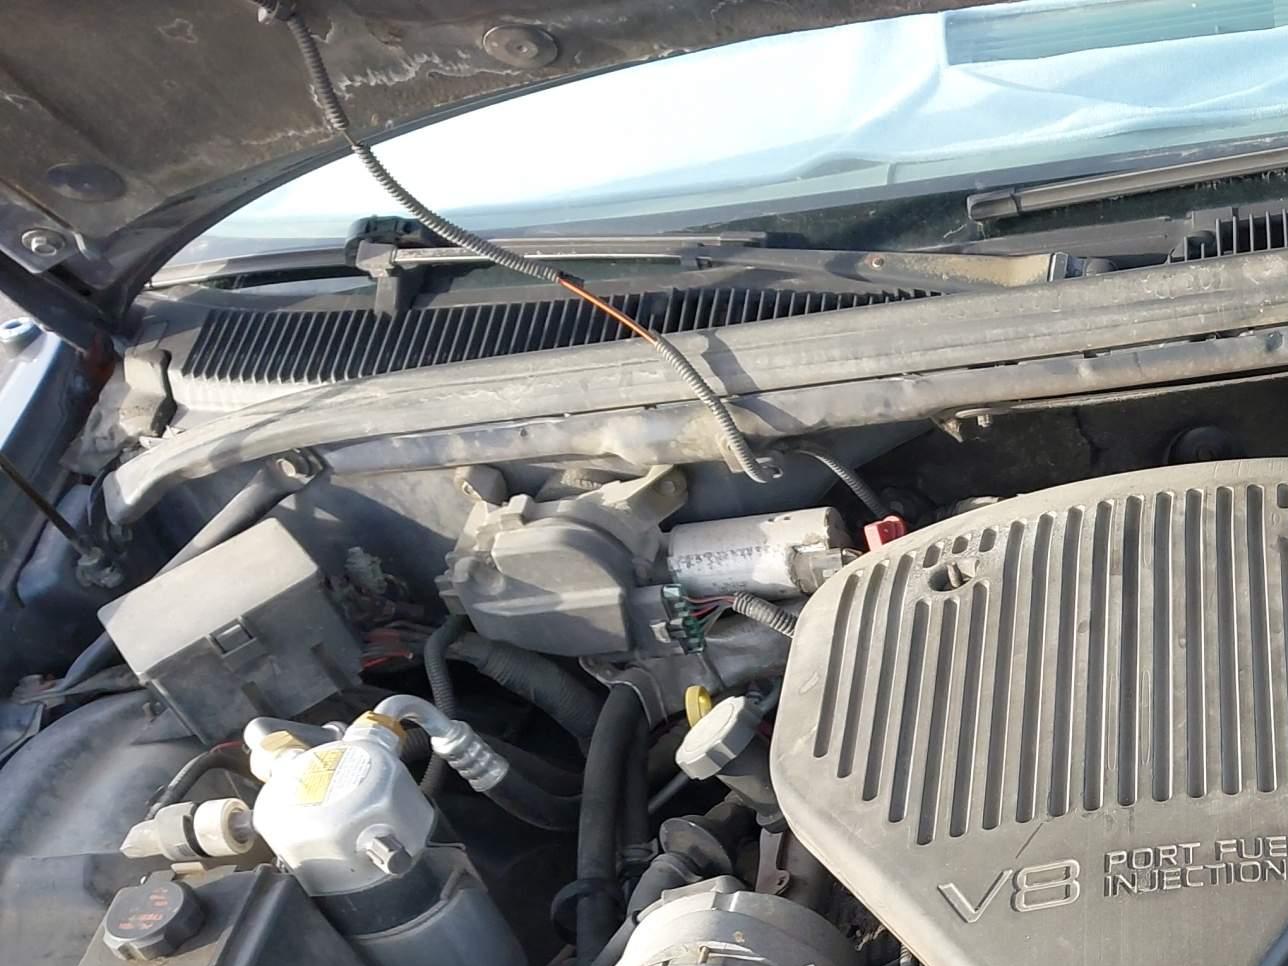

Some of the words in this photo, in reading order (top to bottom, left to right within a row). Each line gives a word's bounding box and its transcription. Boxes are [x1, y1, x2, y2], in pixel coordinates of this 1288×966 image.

[1104, 842, 1200, 873] PORT
[936, 858, 1081, 924] V8
[1103, 858, 1288, 897] INJECTION
